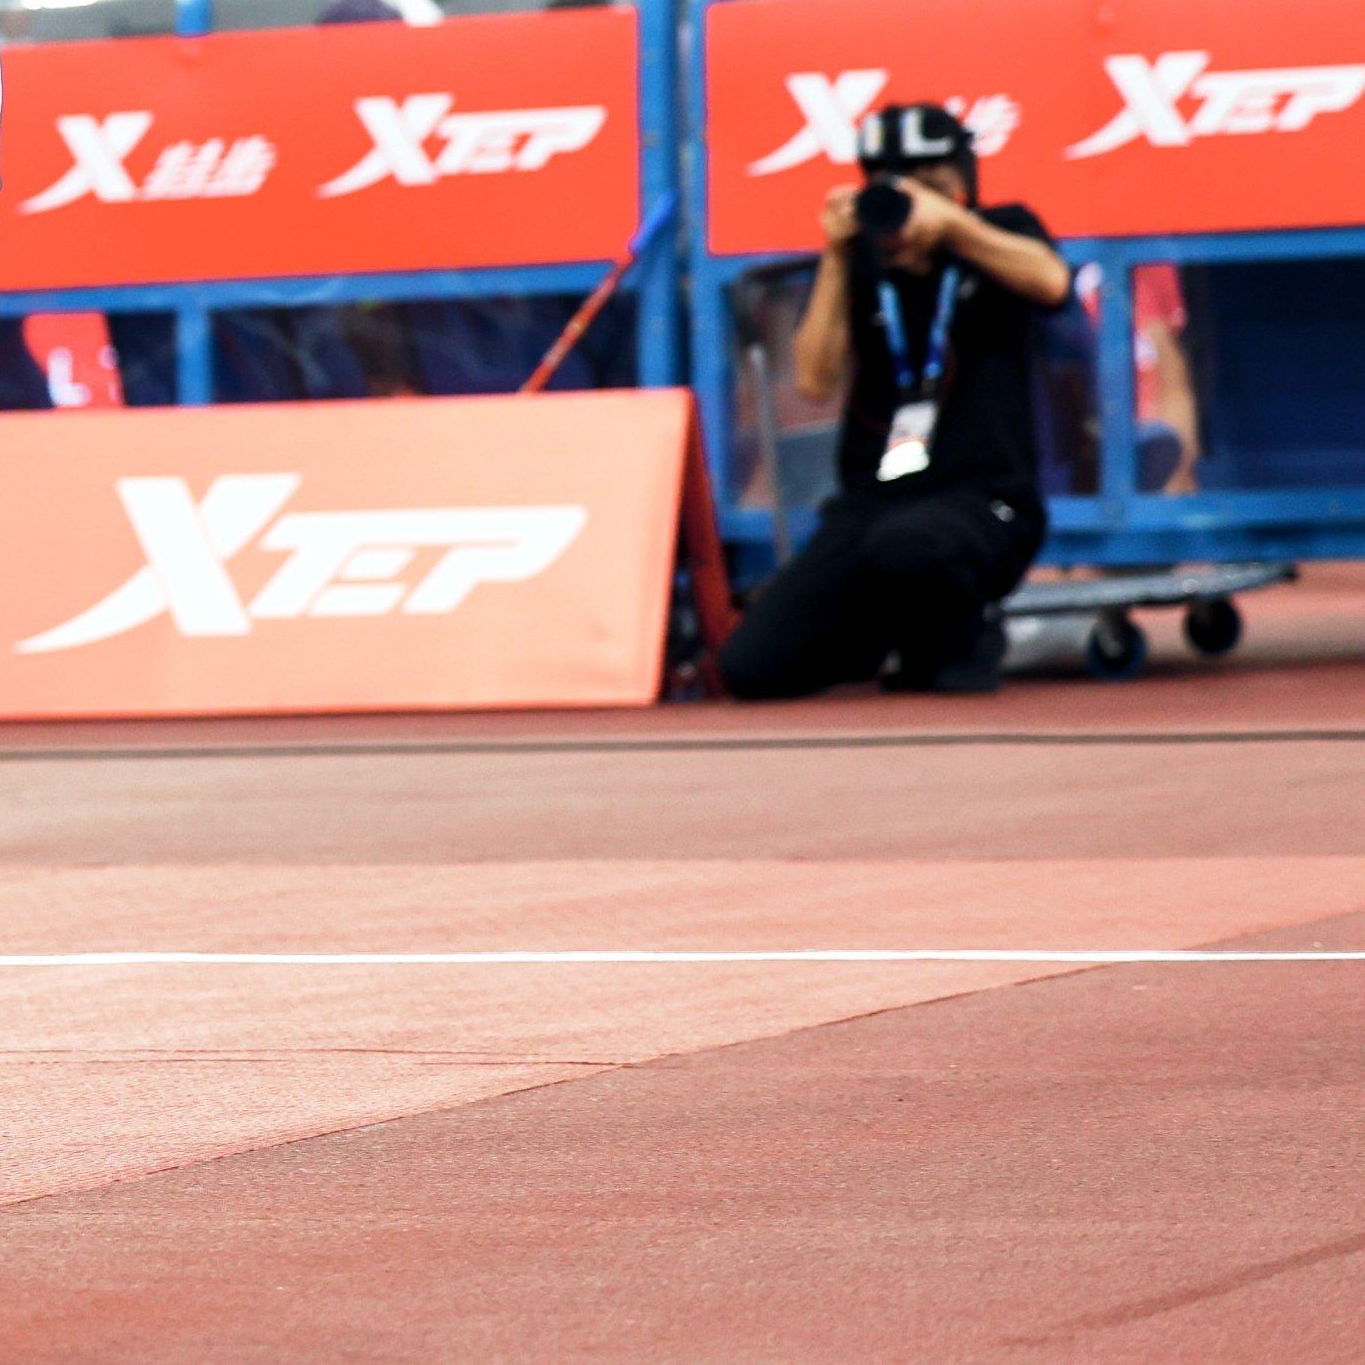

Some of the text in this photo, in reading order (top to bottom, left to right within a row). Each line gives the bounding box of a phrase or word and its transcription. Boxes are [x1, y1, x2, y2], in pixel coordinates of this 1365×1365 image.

[317, 92, 607, 200] XTEP
[1065, 50, 1365, 160] XTEP
[13, 471, 589, 656] XTEP
